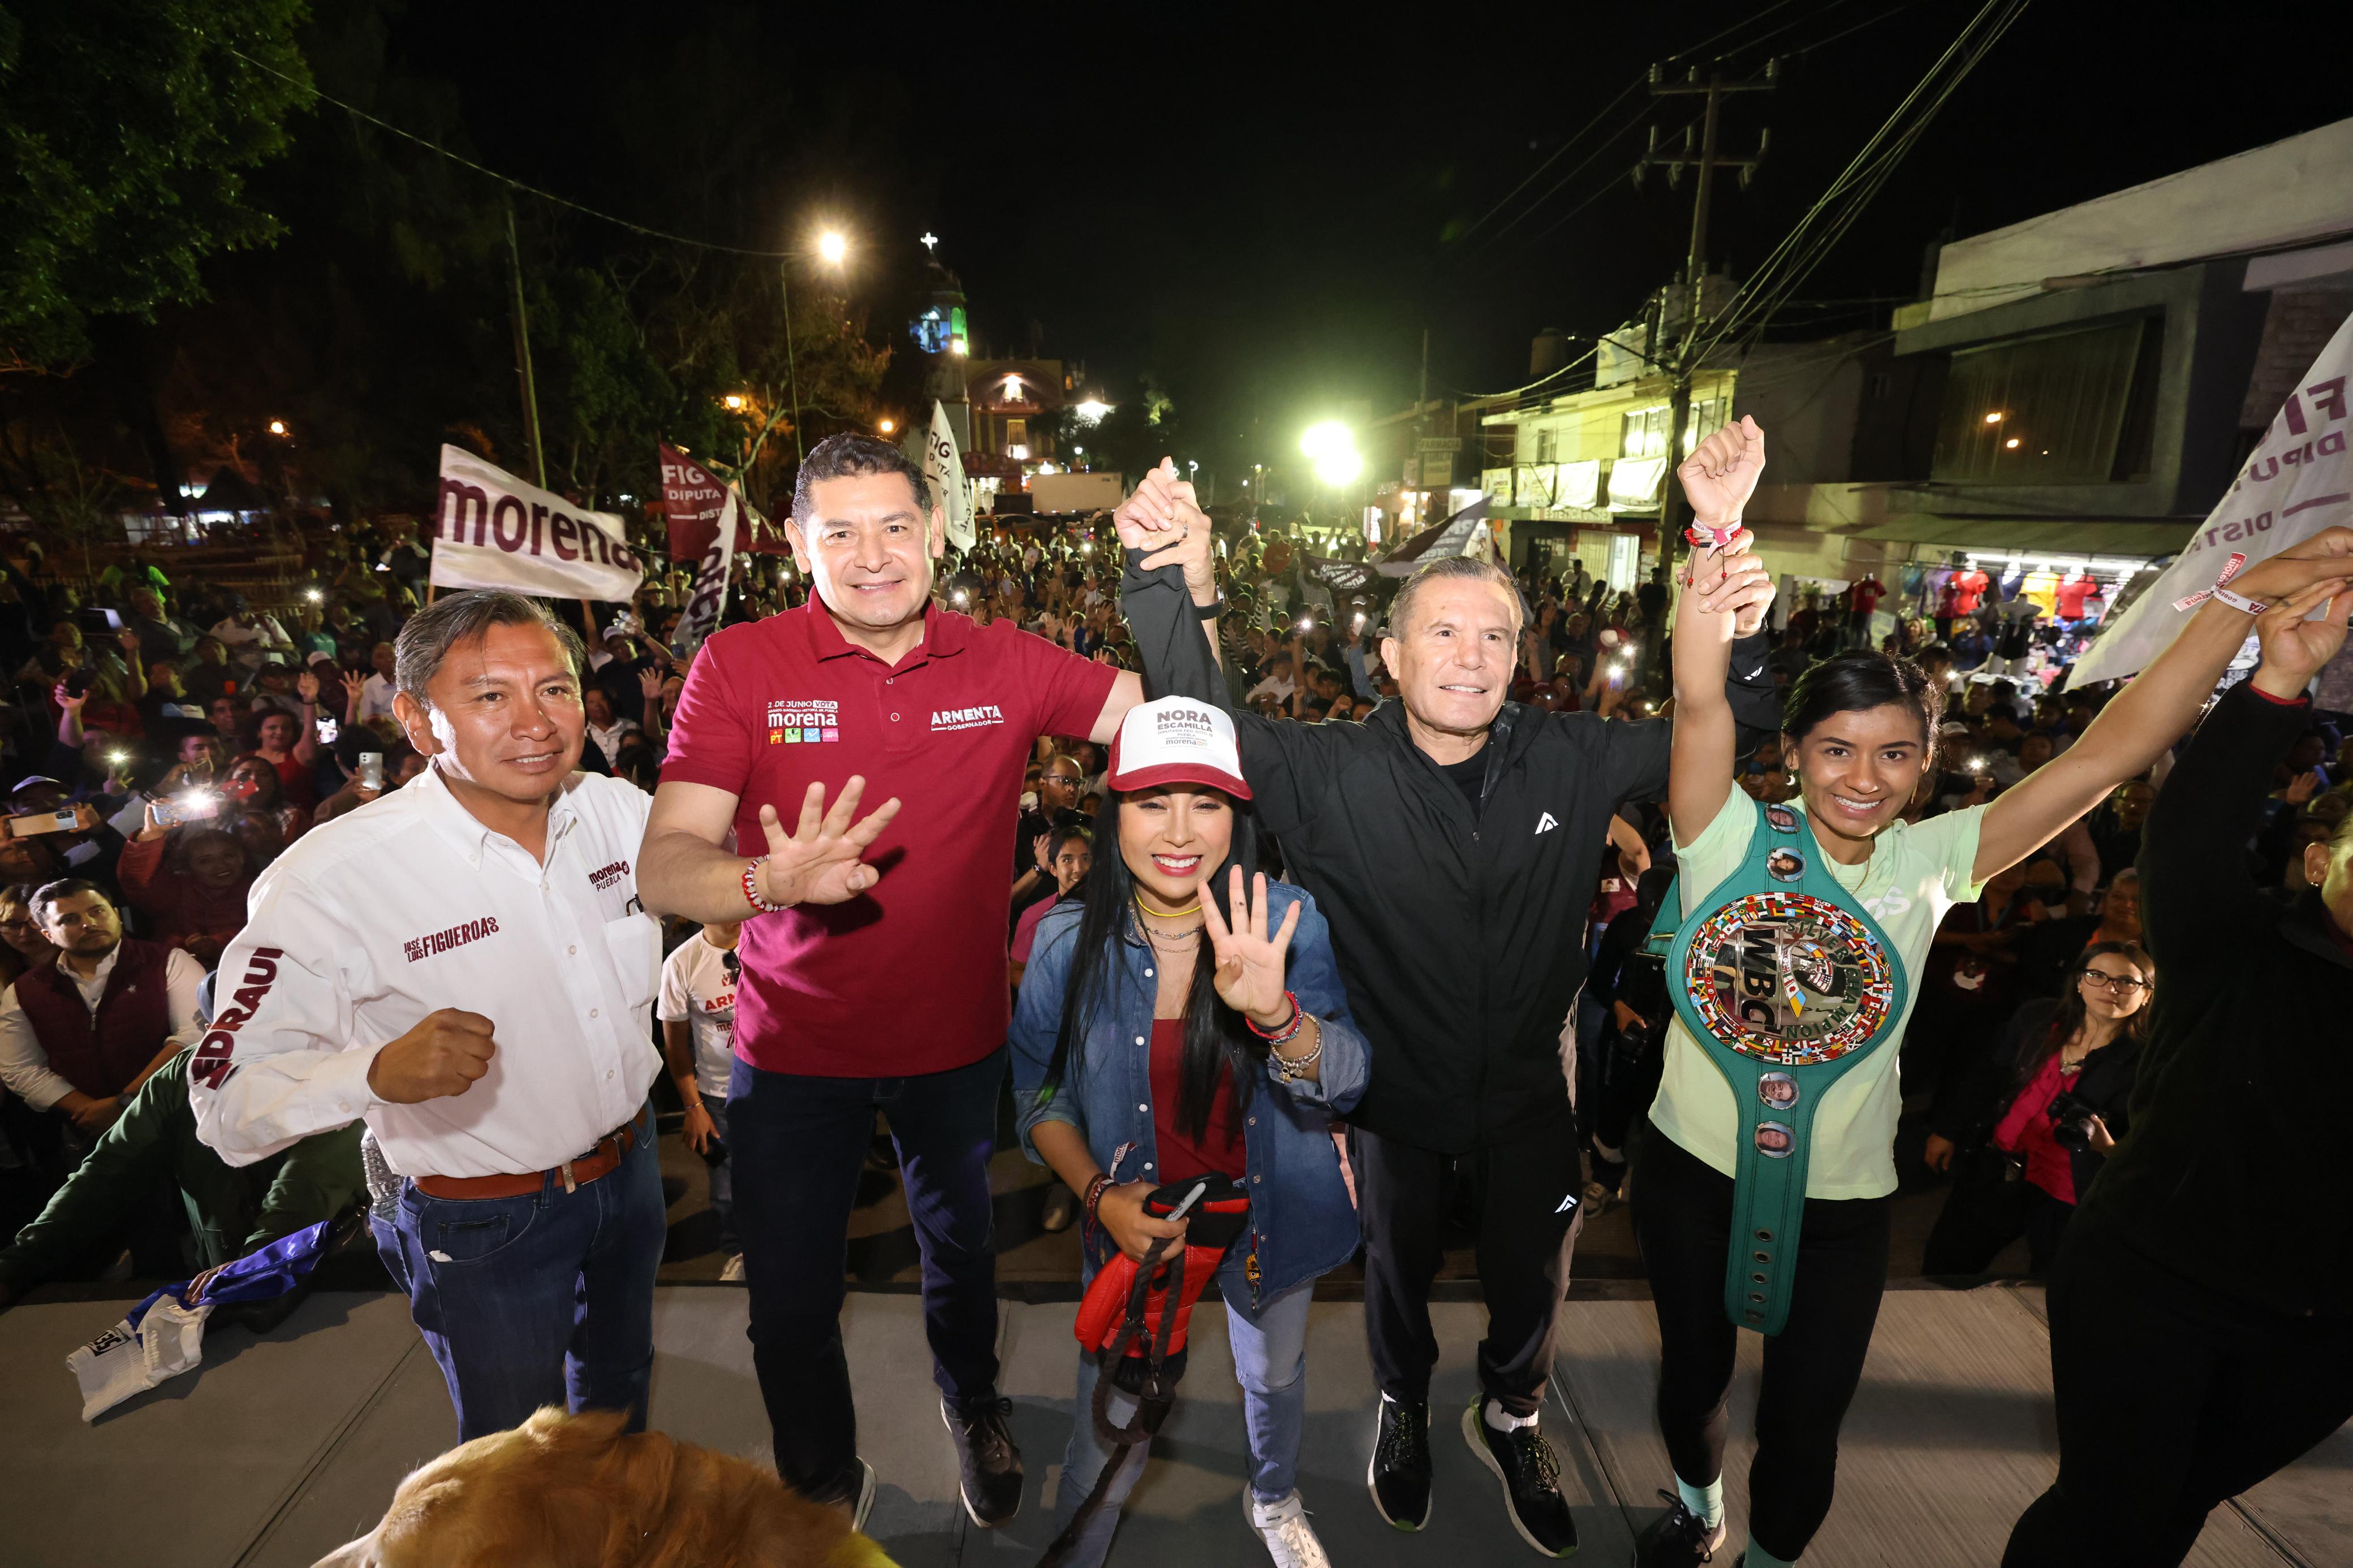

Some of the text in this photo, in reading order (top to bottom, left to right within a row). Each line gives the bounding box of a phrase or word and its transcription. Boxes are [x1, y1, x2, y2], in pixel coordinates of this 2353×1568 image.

[662, 465, 705, 485] FIG
[439, 477, 639, 572] morena
[1693, 521, 1705, 532] rena
[768, 712, 838, 728] morena
[931, 705, 1002, 725] ARMENTA
[1157, 710, 1212, 725] NORA
[947, 719, 992, 731] GOBERNADOR
[1158, 722, 1213, 732] ESCAMILLA
[770, 735, 782, 745] PT
[588, 861, 622, 884] morena
[596, 874, 621, 892] PUEBLA
[404, 936, 421, 953] JOSÉ
[423, 917, 490, 957] FIGUEROA
[1786, 918, 1850, 962] SILVER
[407, 949, 424, 962] LUIS
[1740, 928, 1777, 1027] WBC
[1786, 968, 1861, 1039] CHAMPION
